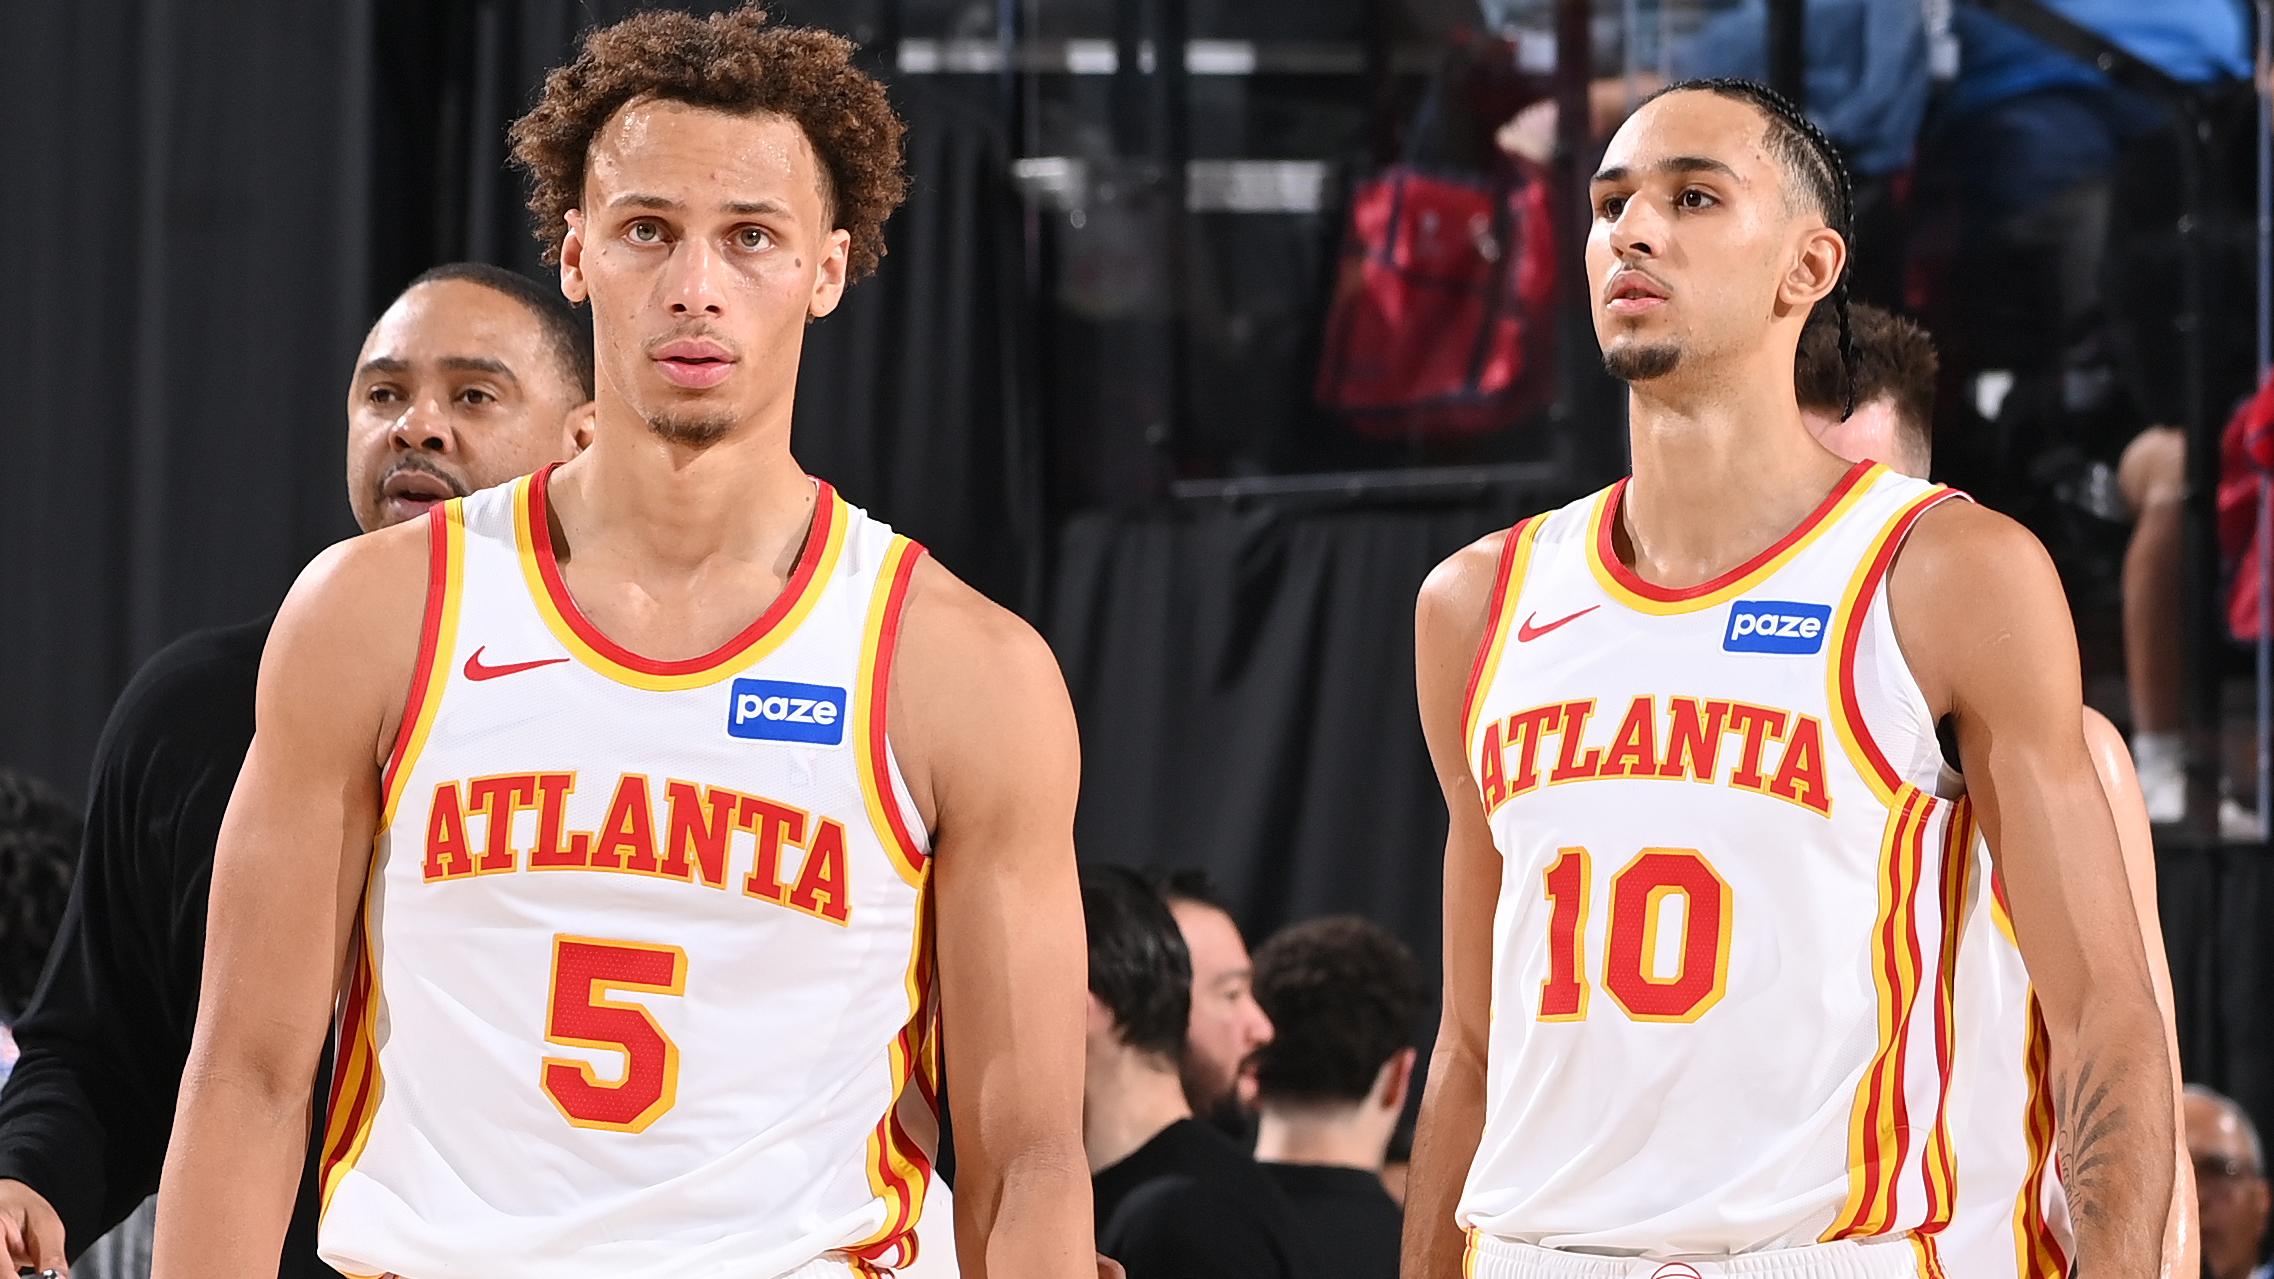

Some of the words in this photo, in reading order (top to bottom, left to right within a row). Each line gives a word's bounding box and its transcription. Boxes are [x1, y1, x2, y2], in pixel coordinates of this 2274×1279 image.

[1731, 612, 1821, 640] paze
[736, 693, 838, 726] paze
[1481, 694, 1834, 819] ATLANTA
[422, 770, 851, 927] ATLANTA
[1537, 846, 1733, 1023] 10
[540, 933, 688, 1134] 5
